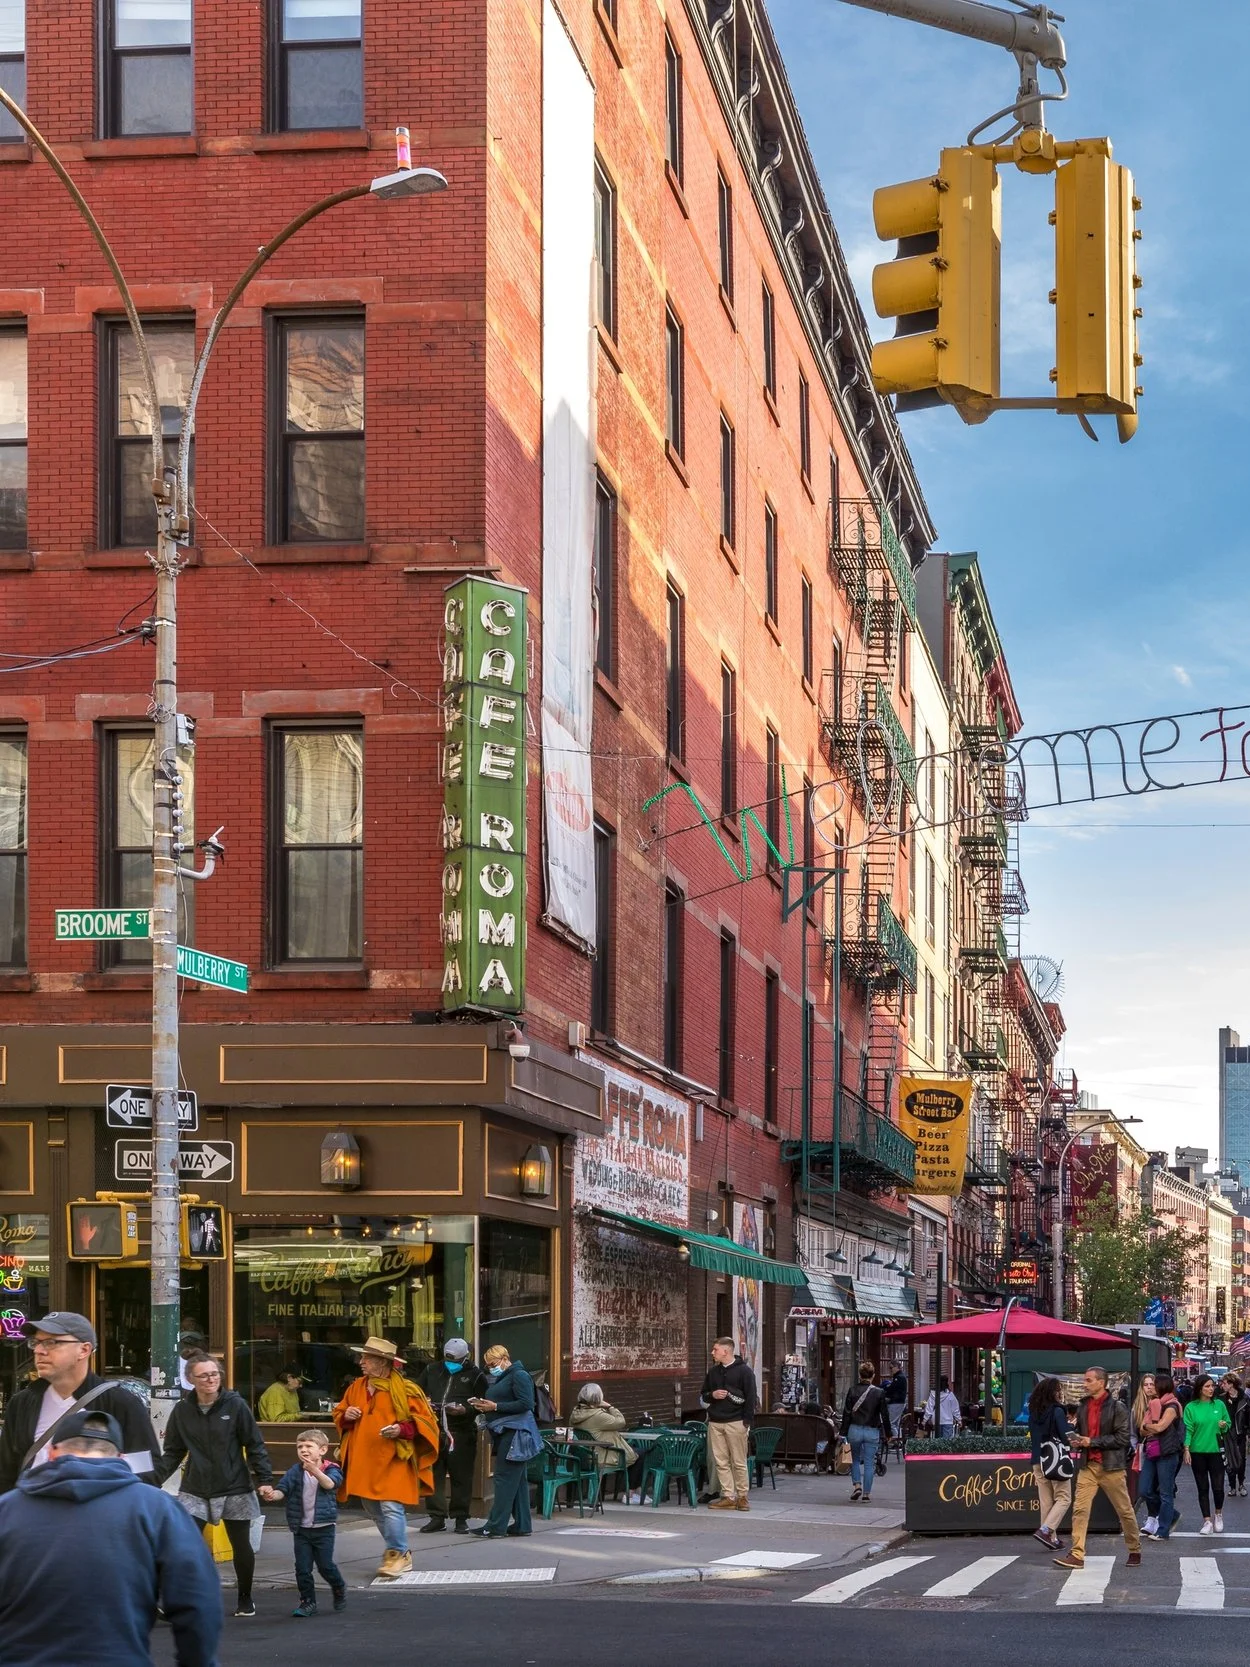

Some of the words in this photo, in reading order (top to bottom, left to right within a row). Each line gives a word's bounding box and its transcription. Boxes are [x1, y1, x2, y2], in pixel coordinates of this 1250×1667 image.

[478, 599, 517, 780] CAFE
[478, 812, 515, 996] ROMA
[57, 913, 132, 936] BROOME
[136, 913, 148, 924] ST
[177, 949, 231, 985] MULBERRY
[235, 968, 245, 978] ST
[119, 1099, 146, 1115] ONE
[916, 1092, 957, 1107] Mulberry
[913, 1105, 939, 1117] Street
[940, 1107, 957, 1118] Bar
[917, 1129, 948, 1140] Beer
[915, 1141, 950, 1152] Pizza
[127, 1152, 152, 1168] ON
[180, 1154, 217, 1169] WAY
[915, 1154, 950, 1164] Pasta
[914, 1166, 957, 1180] urgers
[268, 1303, 295, 1316] FINE
[299, 1303, 344, 1316] ITALIAN
[349, 1303, 406, 1318] PASTRIES
[938, 1474, 994, 1508] Caffè
[995, 1465, 1037, 1495] Rom
[996, 1499, 1026, 1512] SINCE
[1030, 1499, 1040, 1511] 18
